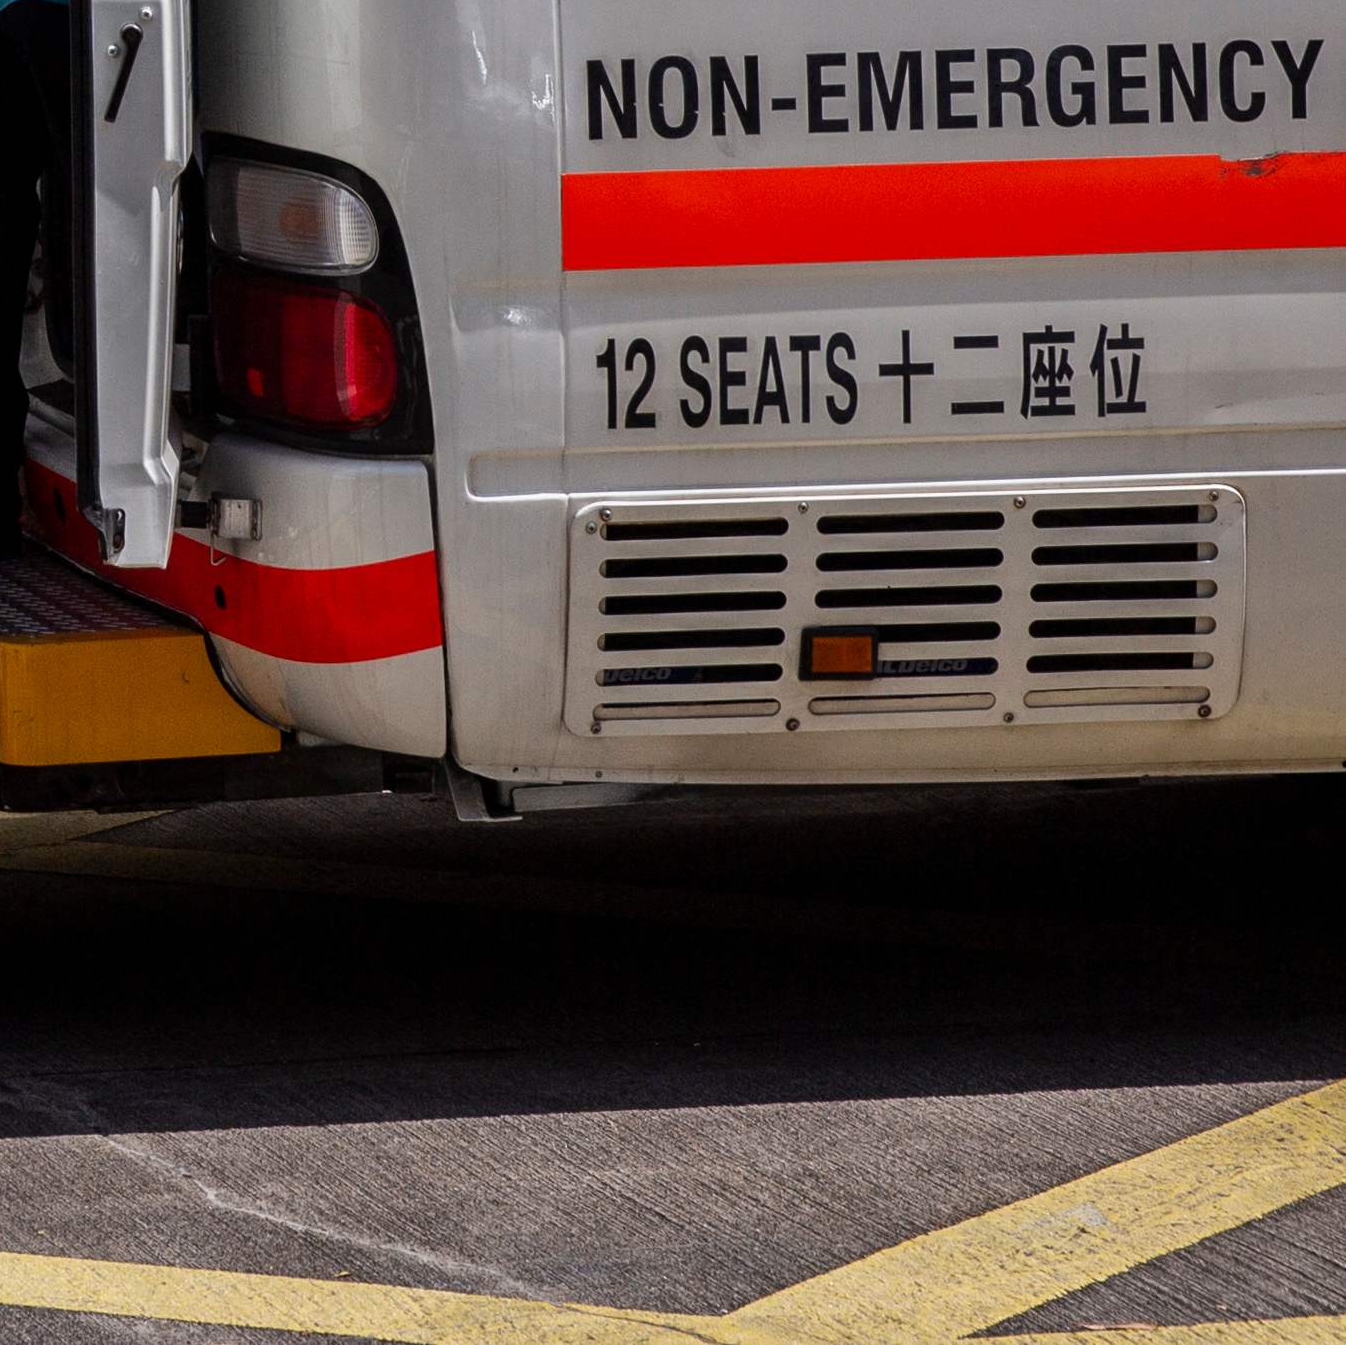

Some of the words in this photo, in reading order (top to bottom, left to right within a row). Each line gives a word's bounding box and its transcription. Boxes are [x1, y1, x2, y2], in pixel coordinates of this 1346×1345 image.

[587, 39, 1324, 141] NON-EMERGENCY
[597, 338, 656, 430] 12
[680, 332, 859, 429] SEATS
[878, 324, 1148, 425] 十二座位
